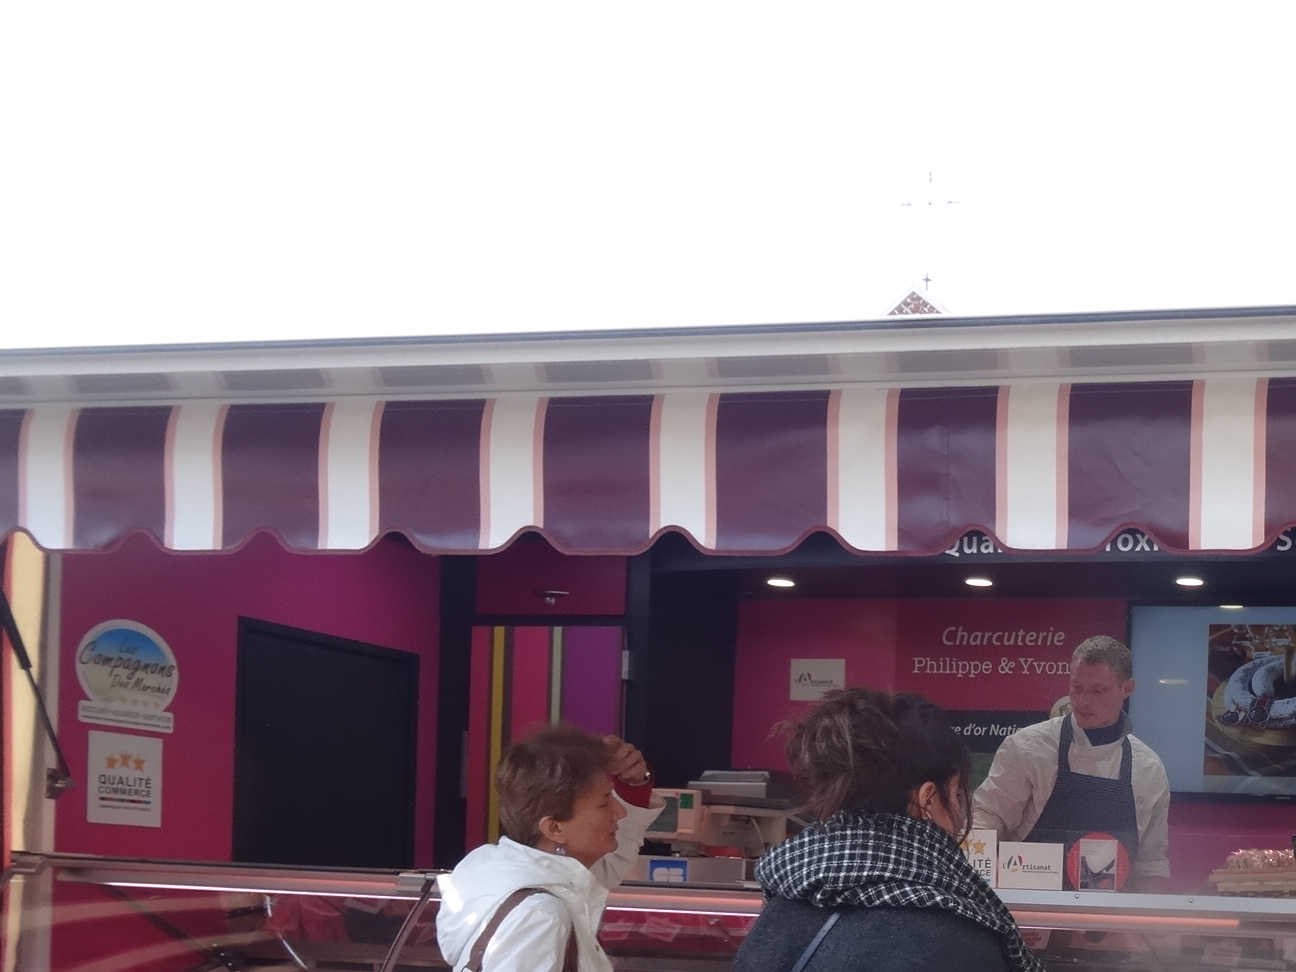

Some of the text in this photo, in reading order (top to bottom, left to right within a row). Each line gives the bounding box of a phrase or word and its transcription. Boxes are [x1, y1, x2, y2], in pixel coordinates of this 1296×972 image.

[942, 626, 1066, 646] Charcuterie
[79, 640, 176, 680] Compagnons
[912, 657, 1071, 678] Philippe & Yvon
[963, 723, 988, 736] d'or
[98, 774, 152, 789] QUALITÉ
[98, 786, 152, 798] COMMERCE
